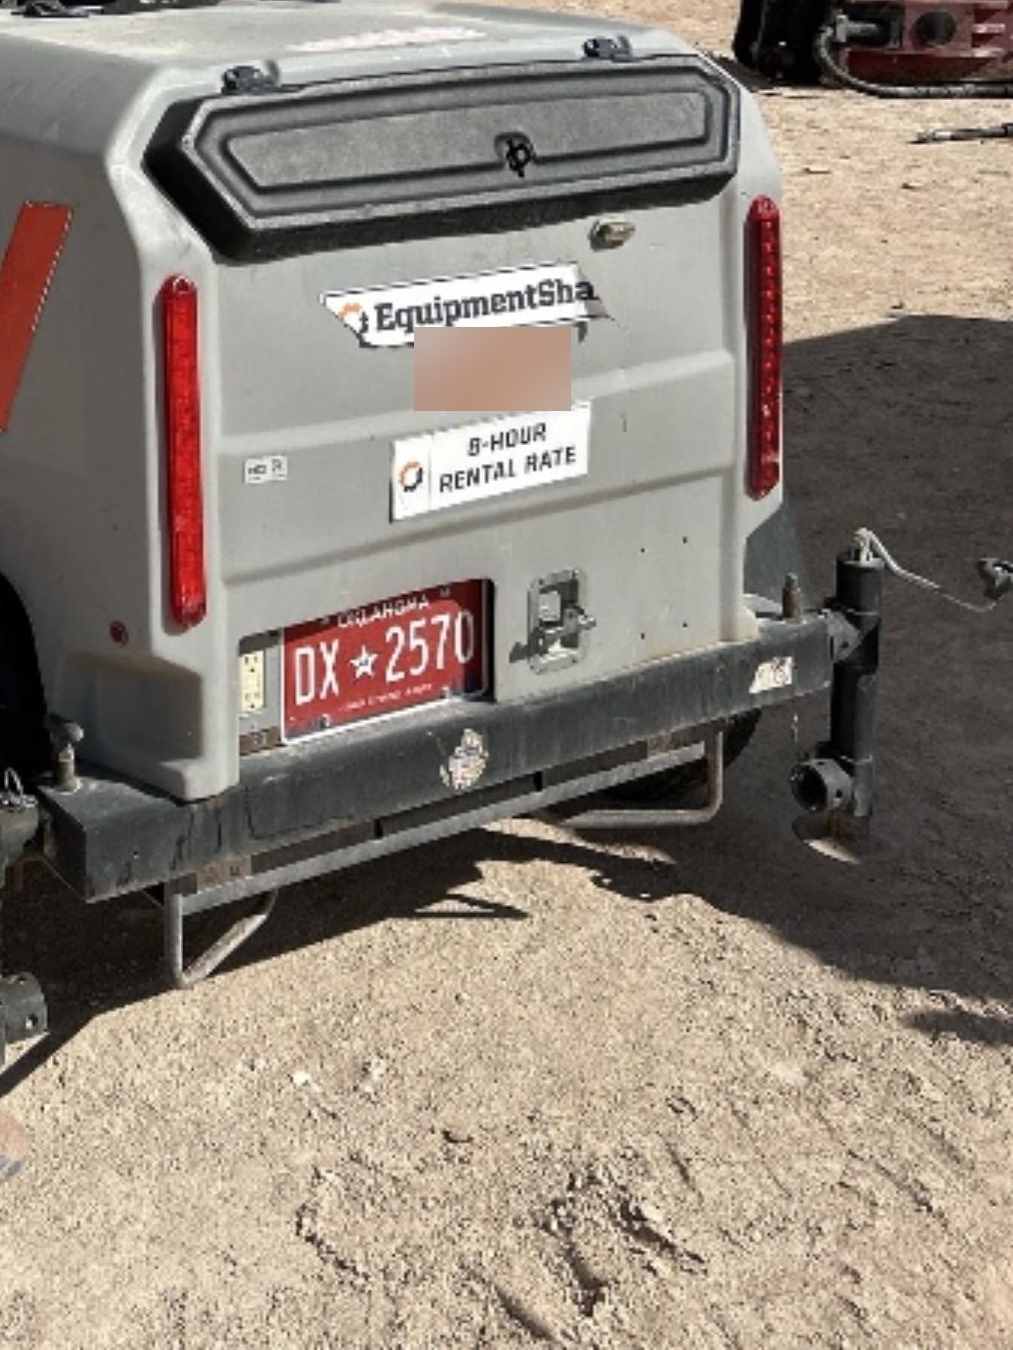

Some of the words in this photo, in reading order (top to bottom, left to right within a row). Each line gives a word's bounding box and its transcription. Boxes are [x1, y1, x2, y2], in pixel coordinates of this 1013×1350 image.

[439, 458, 516, 493] RENTAL
[524, 446, 576, 473] RATE
[295, 638, 339, 705] DX
[385, 609, 474, 682] 2570
